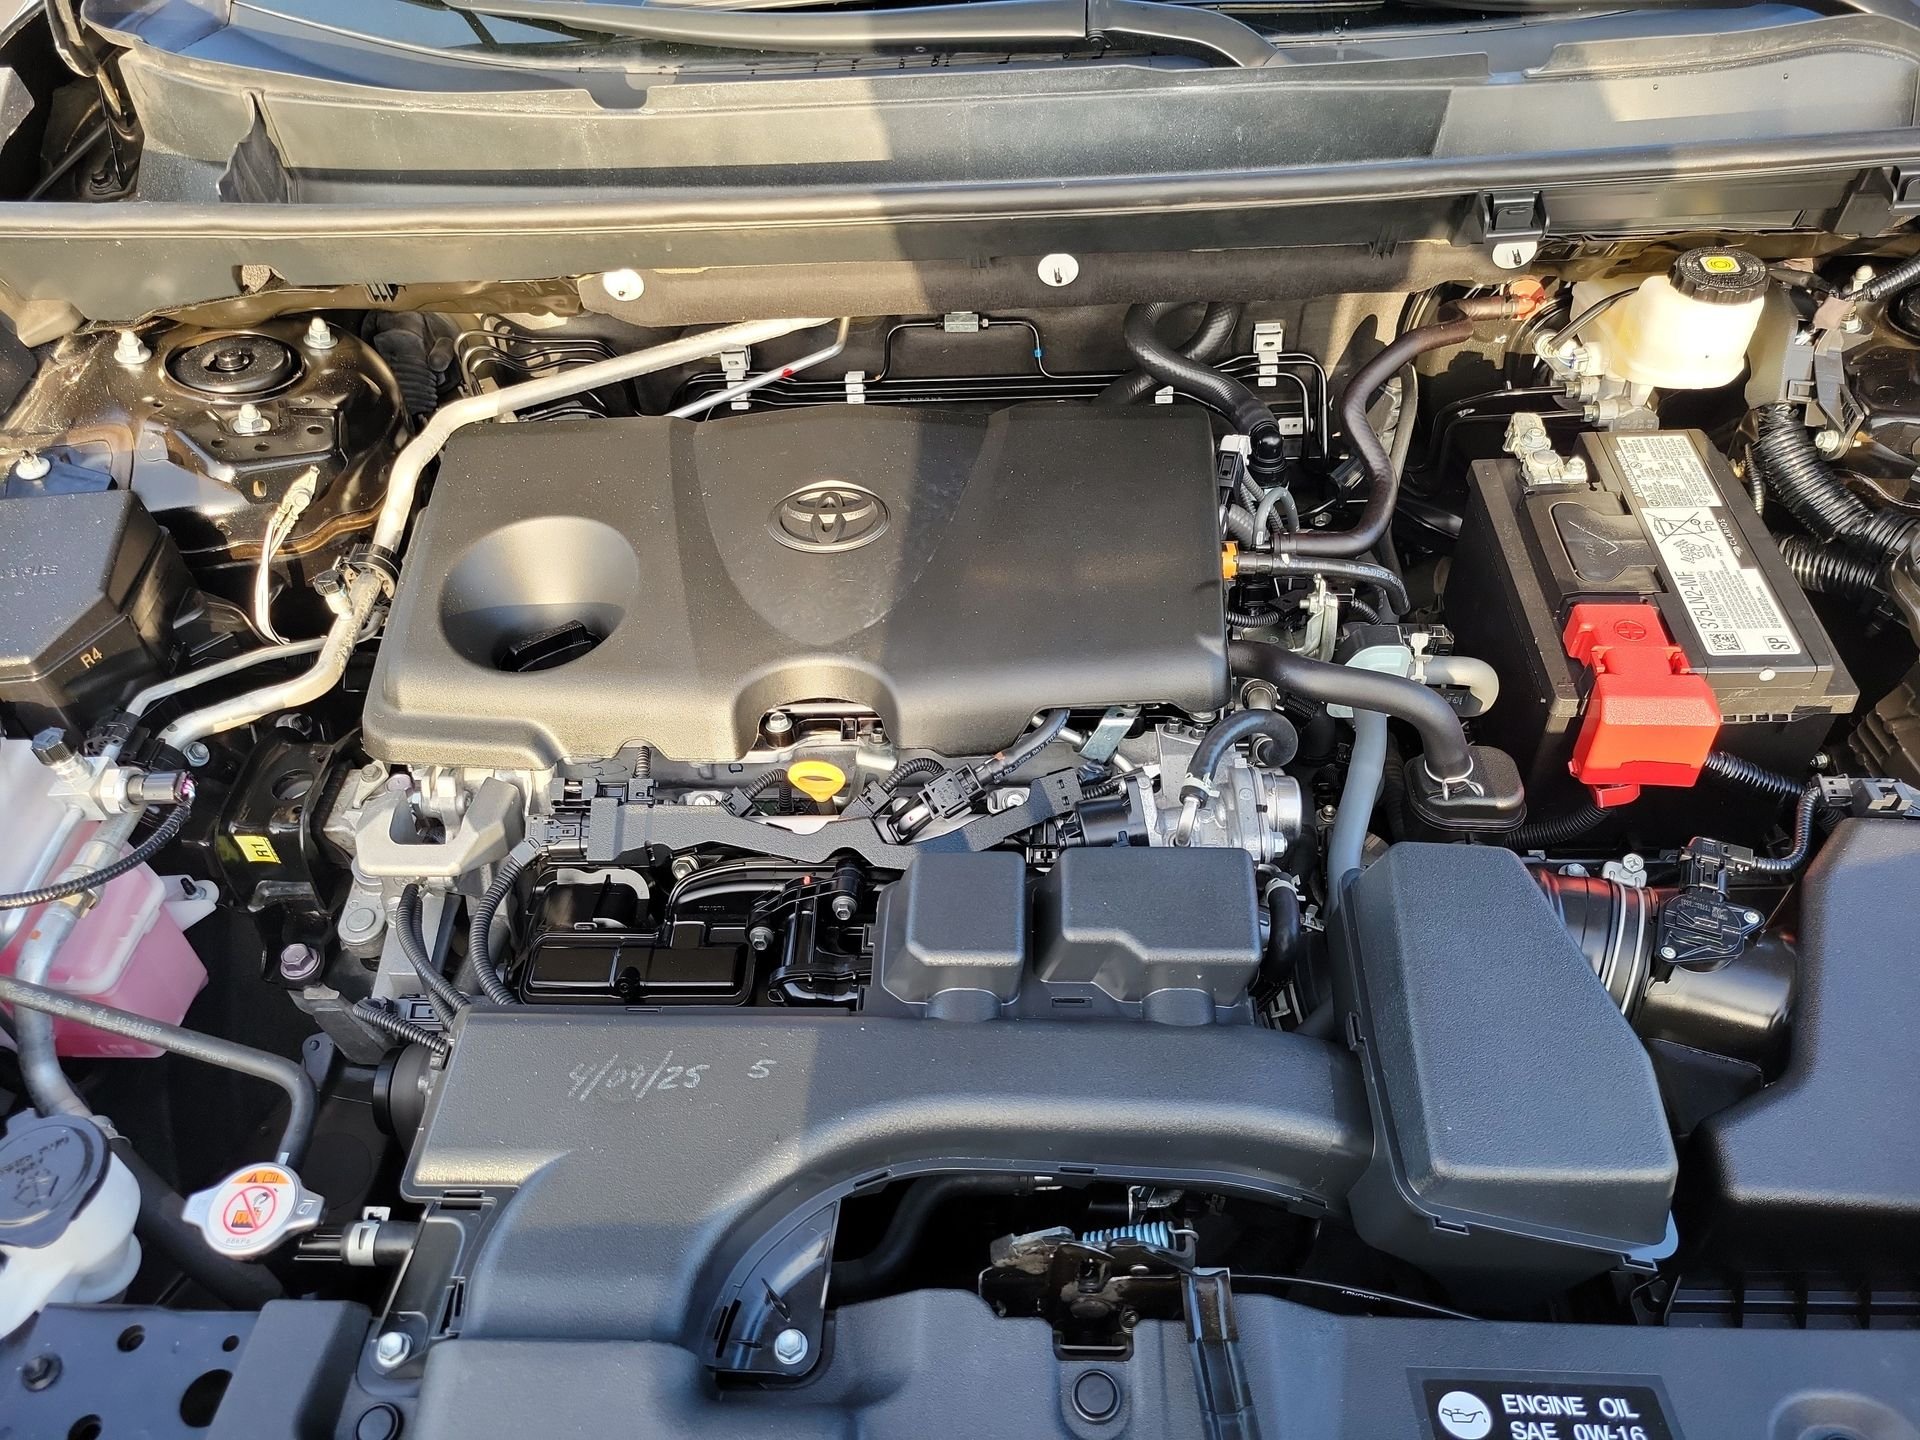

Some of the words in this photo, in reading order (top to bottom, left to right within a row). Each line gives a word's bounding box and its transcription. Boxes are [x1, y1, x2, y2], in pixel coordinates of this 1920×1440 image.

[1703, 519, 1718, 532] Pb
[1718, 517, 1739, 551] CLARIOS
[1674, 571, 1719, 630] 375LN2-MF
[1768, 637, 1791, 650] SP
[80, 647, 103, 669] R4
[251, 843, 271, 858] R1
[747, 1058, 777, 1079] 5
[1501, 1393, 1588, 1417] ENGINE
[1598, 1396, 1641, 1420] OIL
[1510, 1421, 1561, 1440] SAE
[1573, 1423, 1649, 1440] 0W-16
